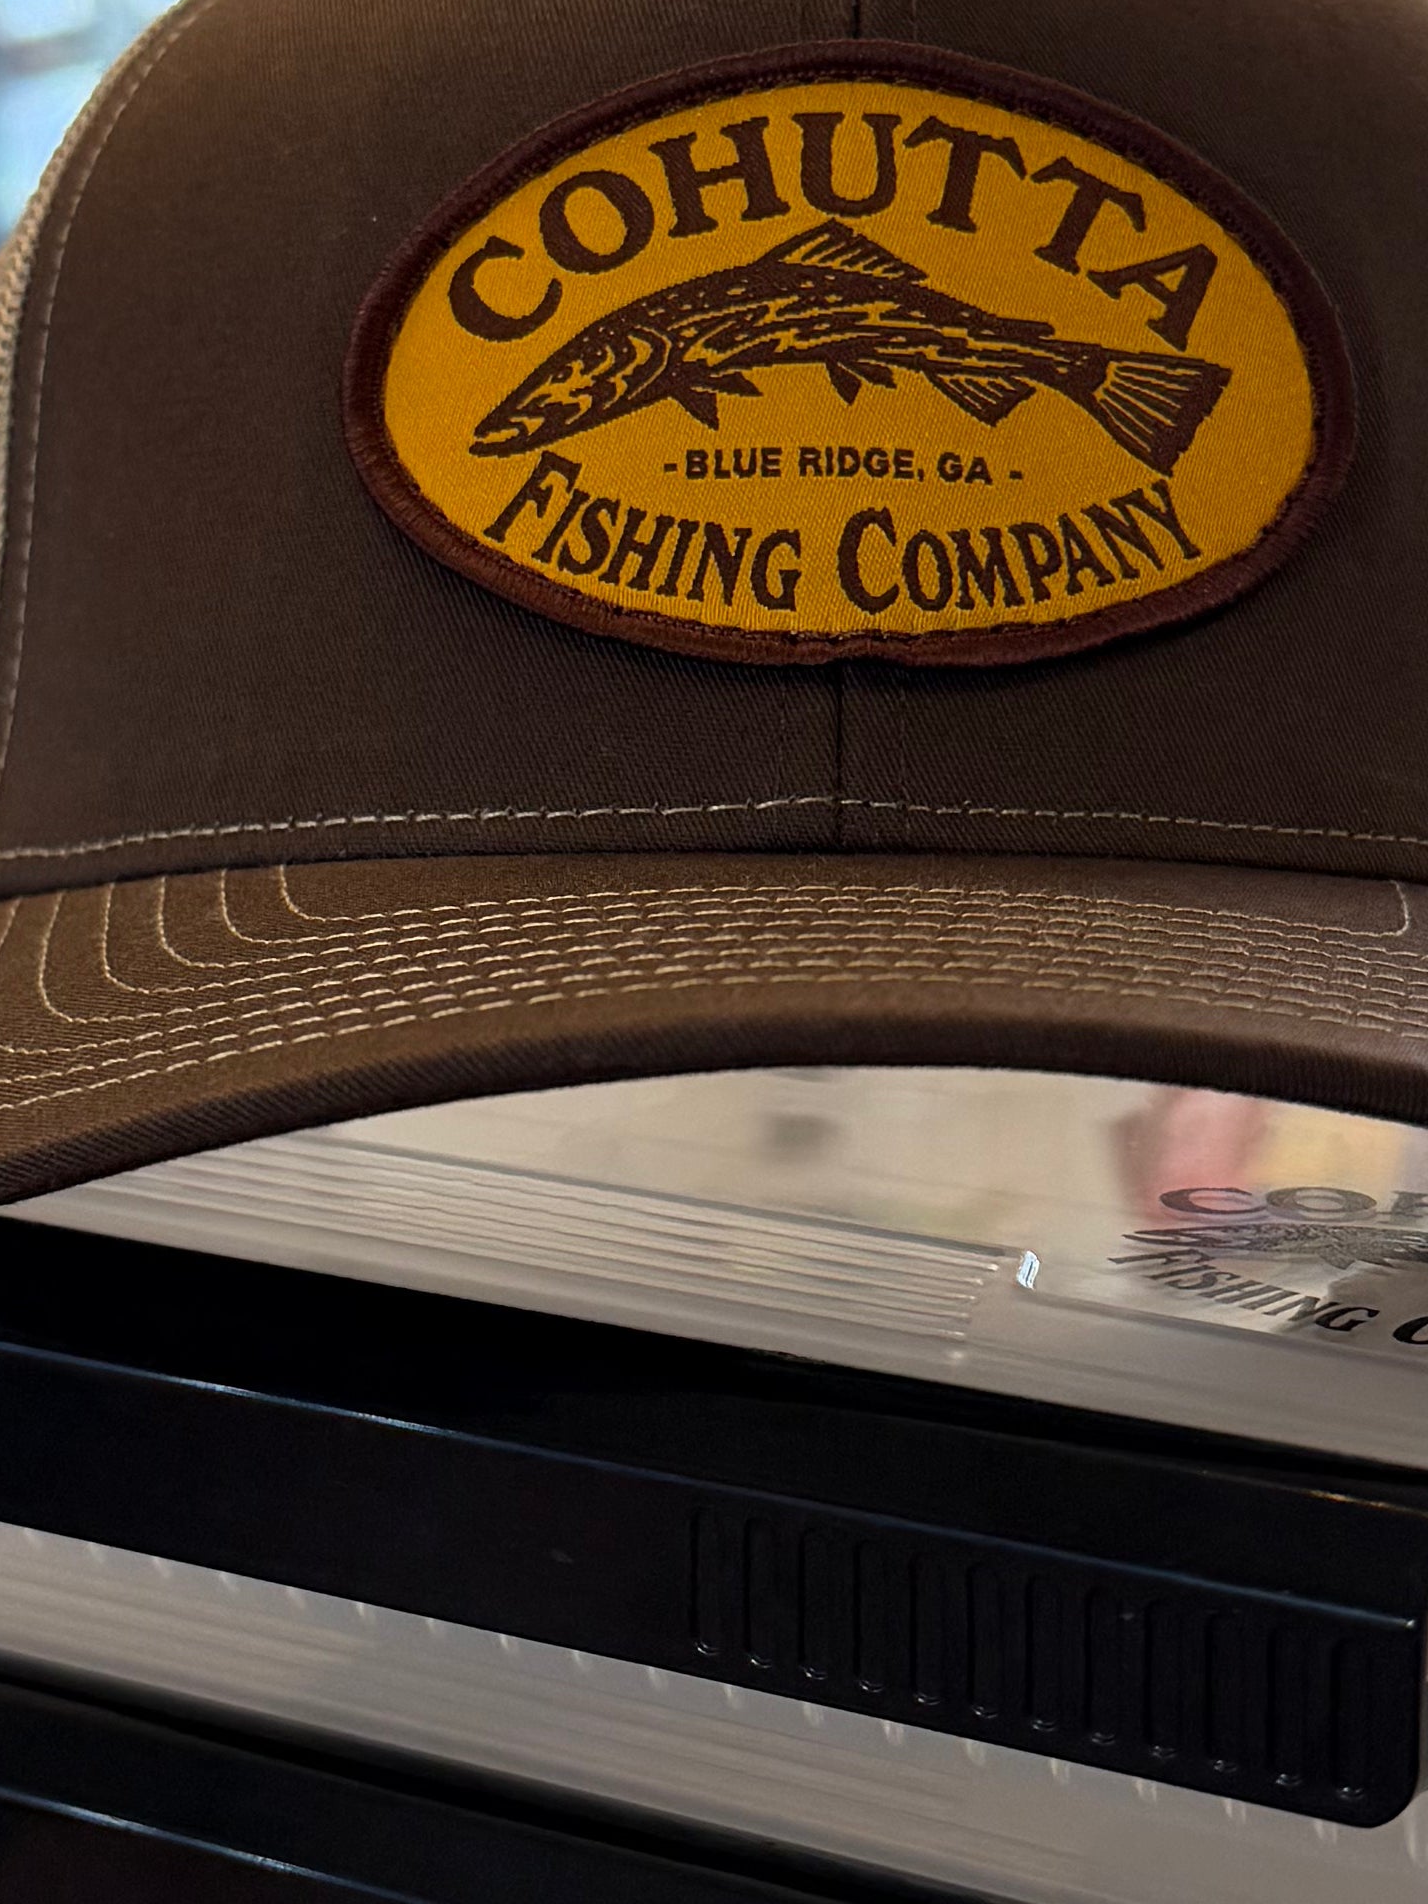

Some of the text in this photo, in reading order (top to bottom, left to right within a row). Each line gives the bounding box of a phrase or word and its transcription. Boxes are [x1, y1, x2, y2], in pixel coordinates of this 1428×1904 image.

[446, 111, 1219, 353] COHUTTA
[797, 445, 925, 484] RIDGE,
[482, 449, 1202, 617] FISHING COMPANY
[1108, 1248, 1381, 1334] FISHING
